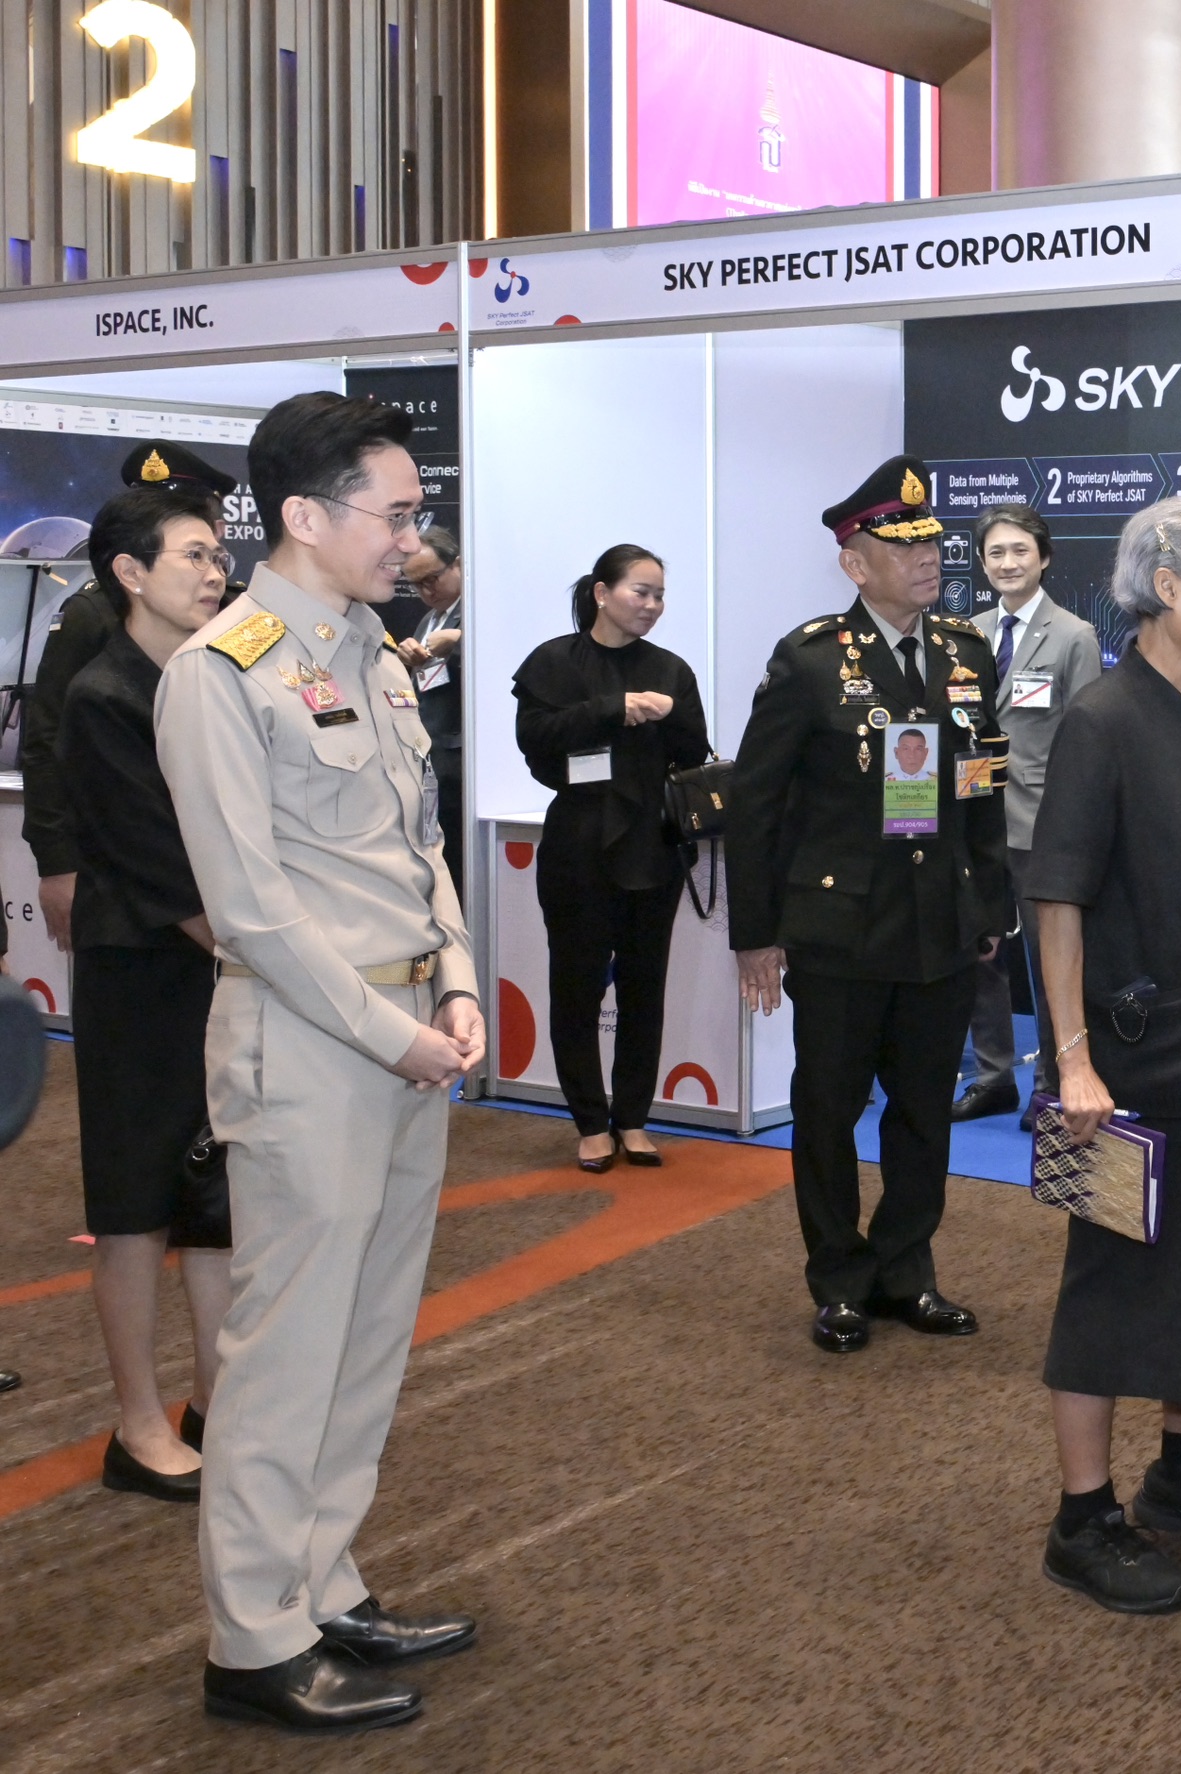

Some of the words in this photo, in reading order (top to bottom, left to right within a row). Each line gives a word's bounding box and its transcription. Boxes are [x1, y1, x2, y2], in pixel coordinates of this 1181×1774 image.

[77, 0, 196, 182] 2
[664, 260, 714, 292] SKY
[721, 249, 838, 287] PERFECT
[845, 243, 909, 282] JSAT
[915, 222, 1151, 270] CORPORATION
[96, 308, 167, 336] ISPACE,
[173, 304, 214, 330] INC.
[420, 466, 459, 477] Connec
[1067, 470, 1110, 486] Proprietary
[1111, 470, 1153, 485] Algorithms
[421, 482, 441, 494] rvice
[949, 475, 967, 488] Data
[969, 474, 987, 487] from
[988, 473, 1019, 488] Multiple
[1047, 468, 1062, 505] 2
[929, 471, 938, 507] 1
[1067, 490, 1076, 503] of
[1077, 490, 1093, 503] SKY
[1094, 488, 1124, 502] Perfect
[1126, 488, 1146, 502] JSAT
[949, 493, 978, 507] Sensing
[979, 490, 1027, 506] Technologies
[224, 525, 264, 541] EXPO
[976, 591, 992, 602] SAR
